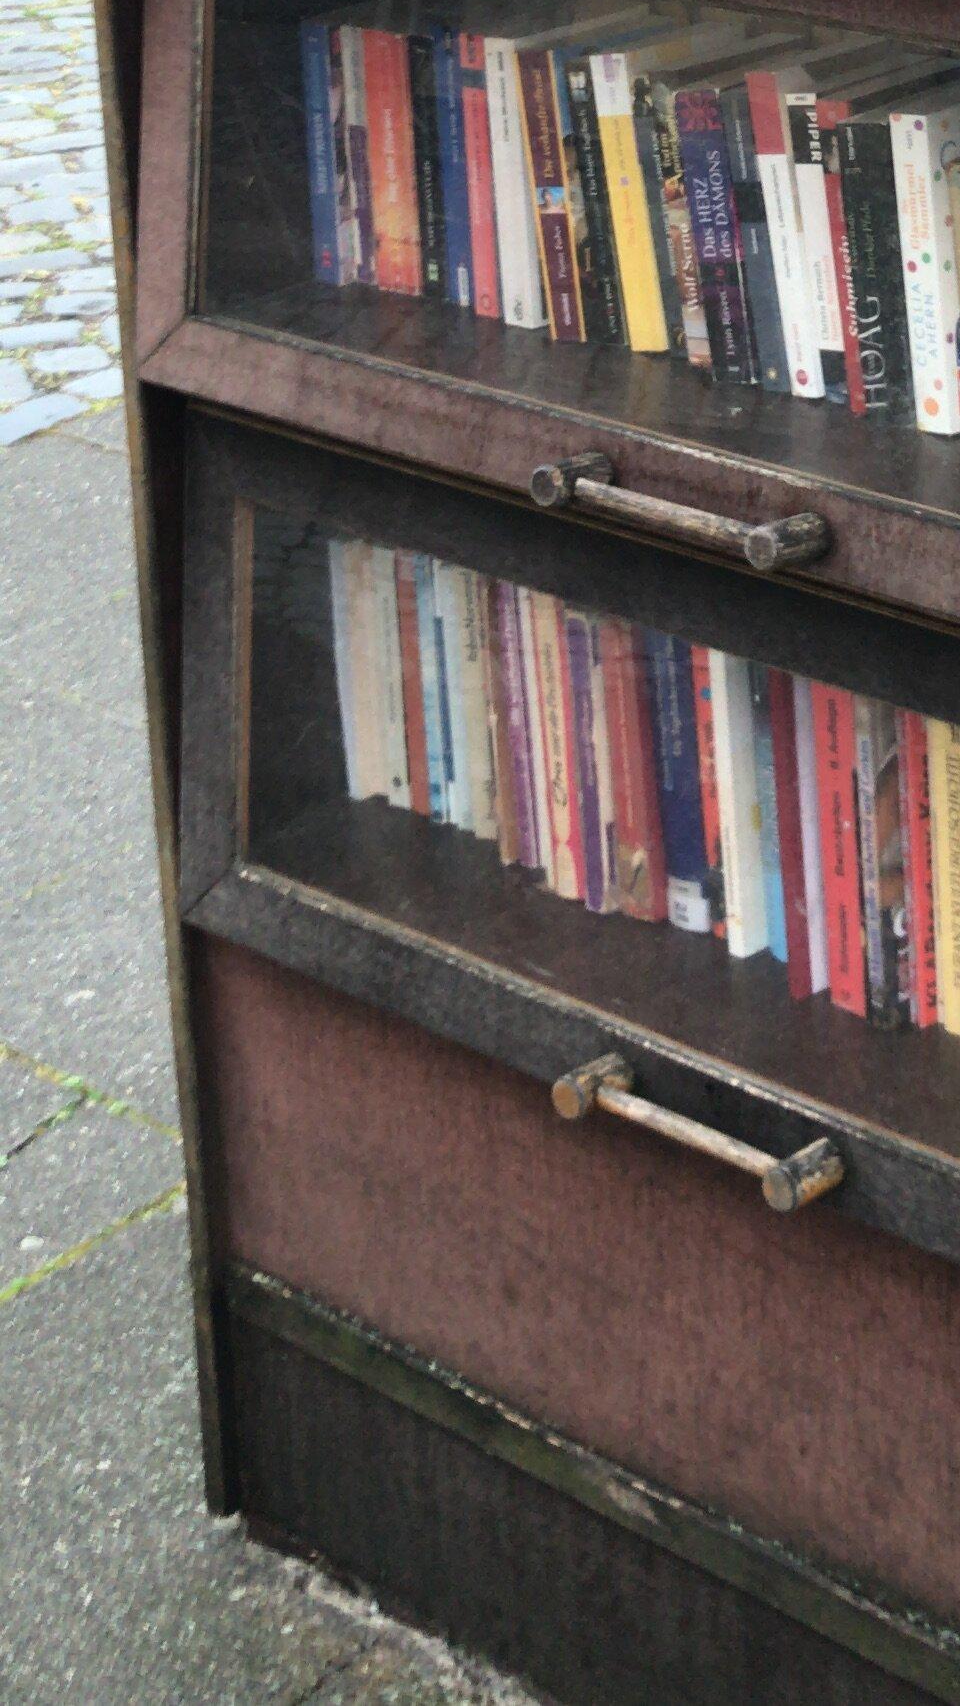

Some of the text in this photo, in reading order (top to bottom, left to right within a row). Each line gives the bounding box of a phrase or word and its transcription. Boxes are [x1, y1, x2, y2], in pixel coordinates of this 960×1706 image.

[803, 108, 822, 162] PIPER
[693, 177, 717, 259] Das HERZ
[705, 149, 733, 258] des DÄMONS
[677, 222, 699, 313] Wolf Serno
[718, 289, 736, 356] Lynn Raven
[855, 295, 888, 409] HOAG
[911, 283, 928, 367] CECELIA
[924, 294, 938, 358] AHERN
